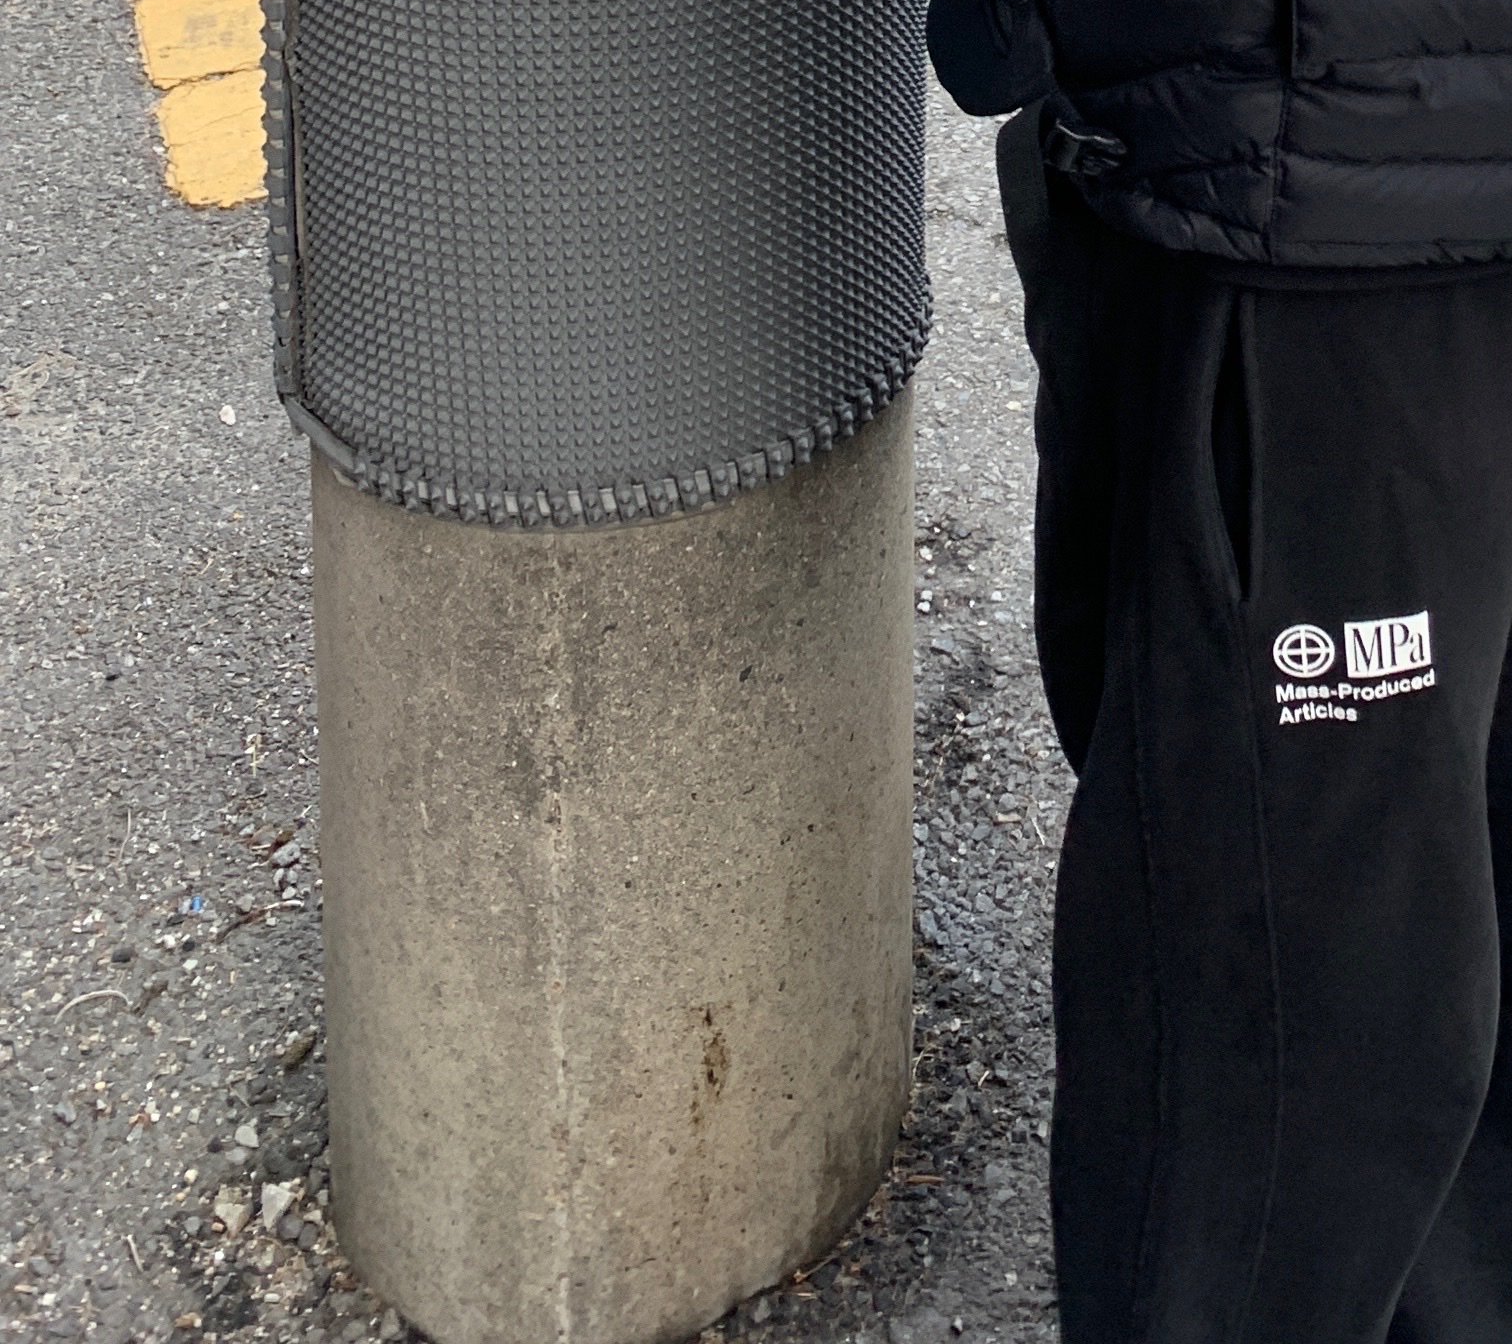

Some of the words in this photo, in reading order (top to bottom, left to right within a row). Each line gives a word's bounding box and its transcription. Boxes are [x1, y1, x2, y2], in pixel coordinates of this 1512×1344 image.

[1352, 622, 1426, 673] MPa
[1275, 668, 1436, 704] Mass-Produced
[1278, 702, 1358, 725] Articles
